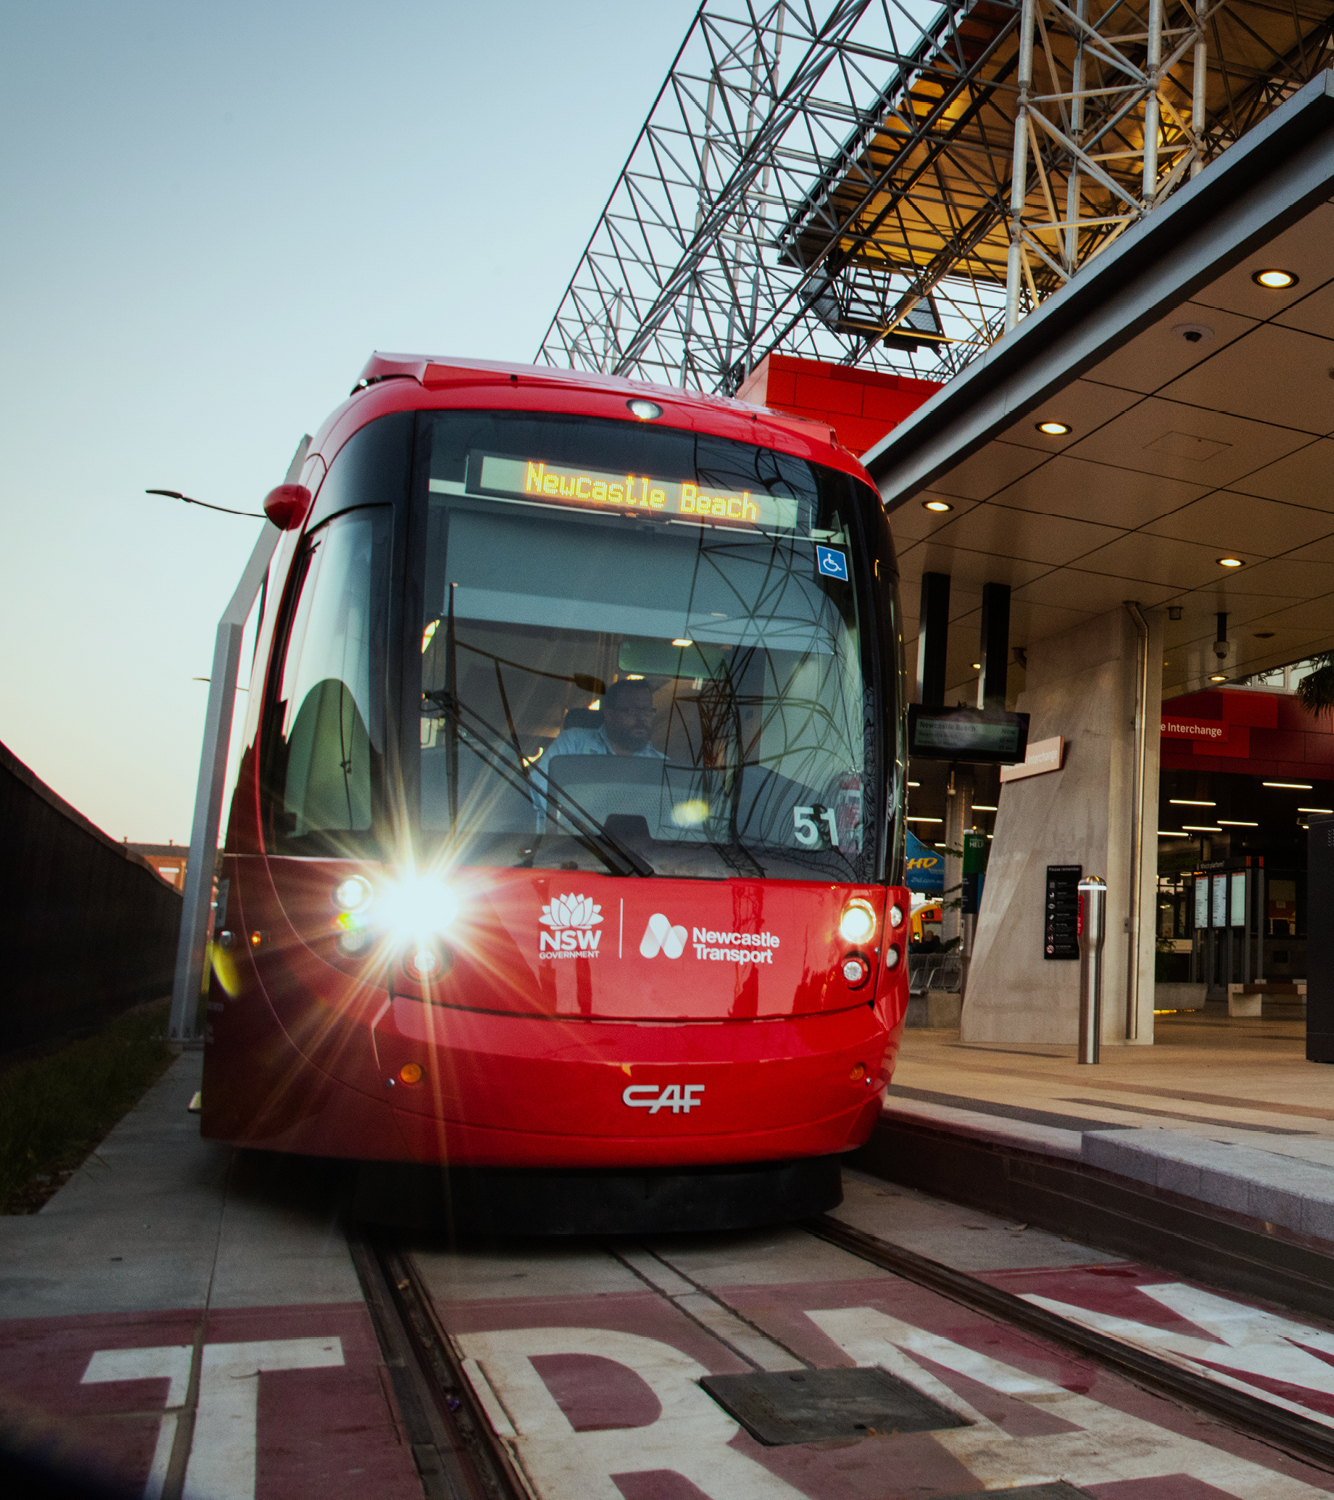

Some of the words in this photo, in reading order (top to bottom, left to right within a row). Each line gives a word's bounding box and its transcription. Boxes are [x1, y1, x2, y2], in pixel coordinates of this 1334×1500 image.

[525, 461, 666, 509] Newcastle
[680, 482, 758, 521] Beach
[1167, 722, 1222, 738] Interchange
[793, 805, 840, 846] 51
[906, 857, 938, 870] HD
[540, 929, 603, 951] NSW
[692, 927, 781, 948] Newcastle
[539, 951, 600, 960] GOVERNMENT
[693, 943, 774, 965] Transport
[622, 1084, 705, 1114] CAF
